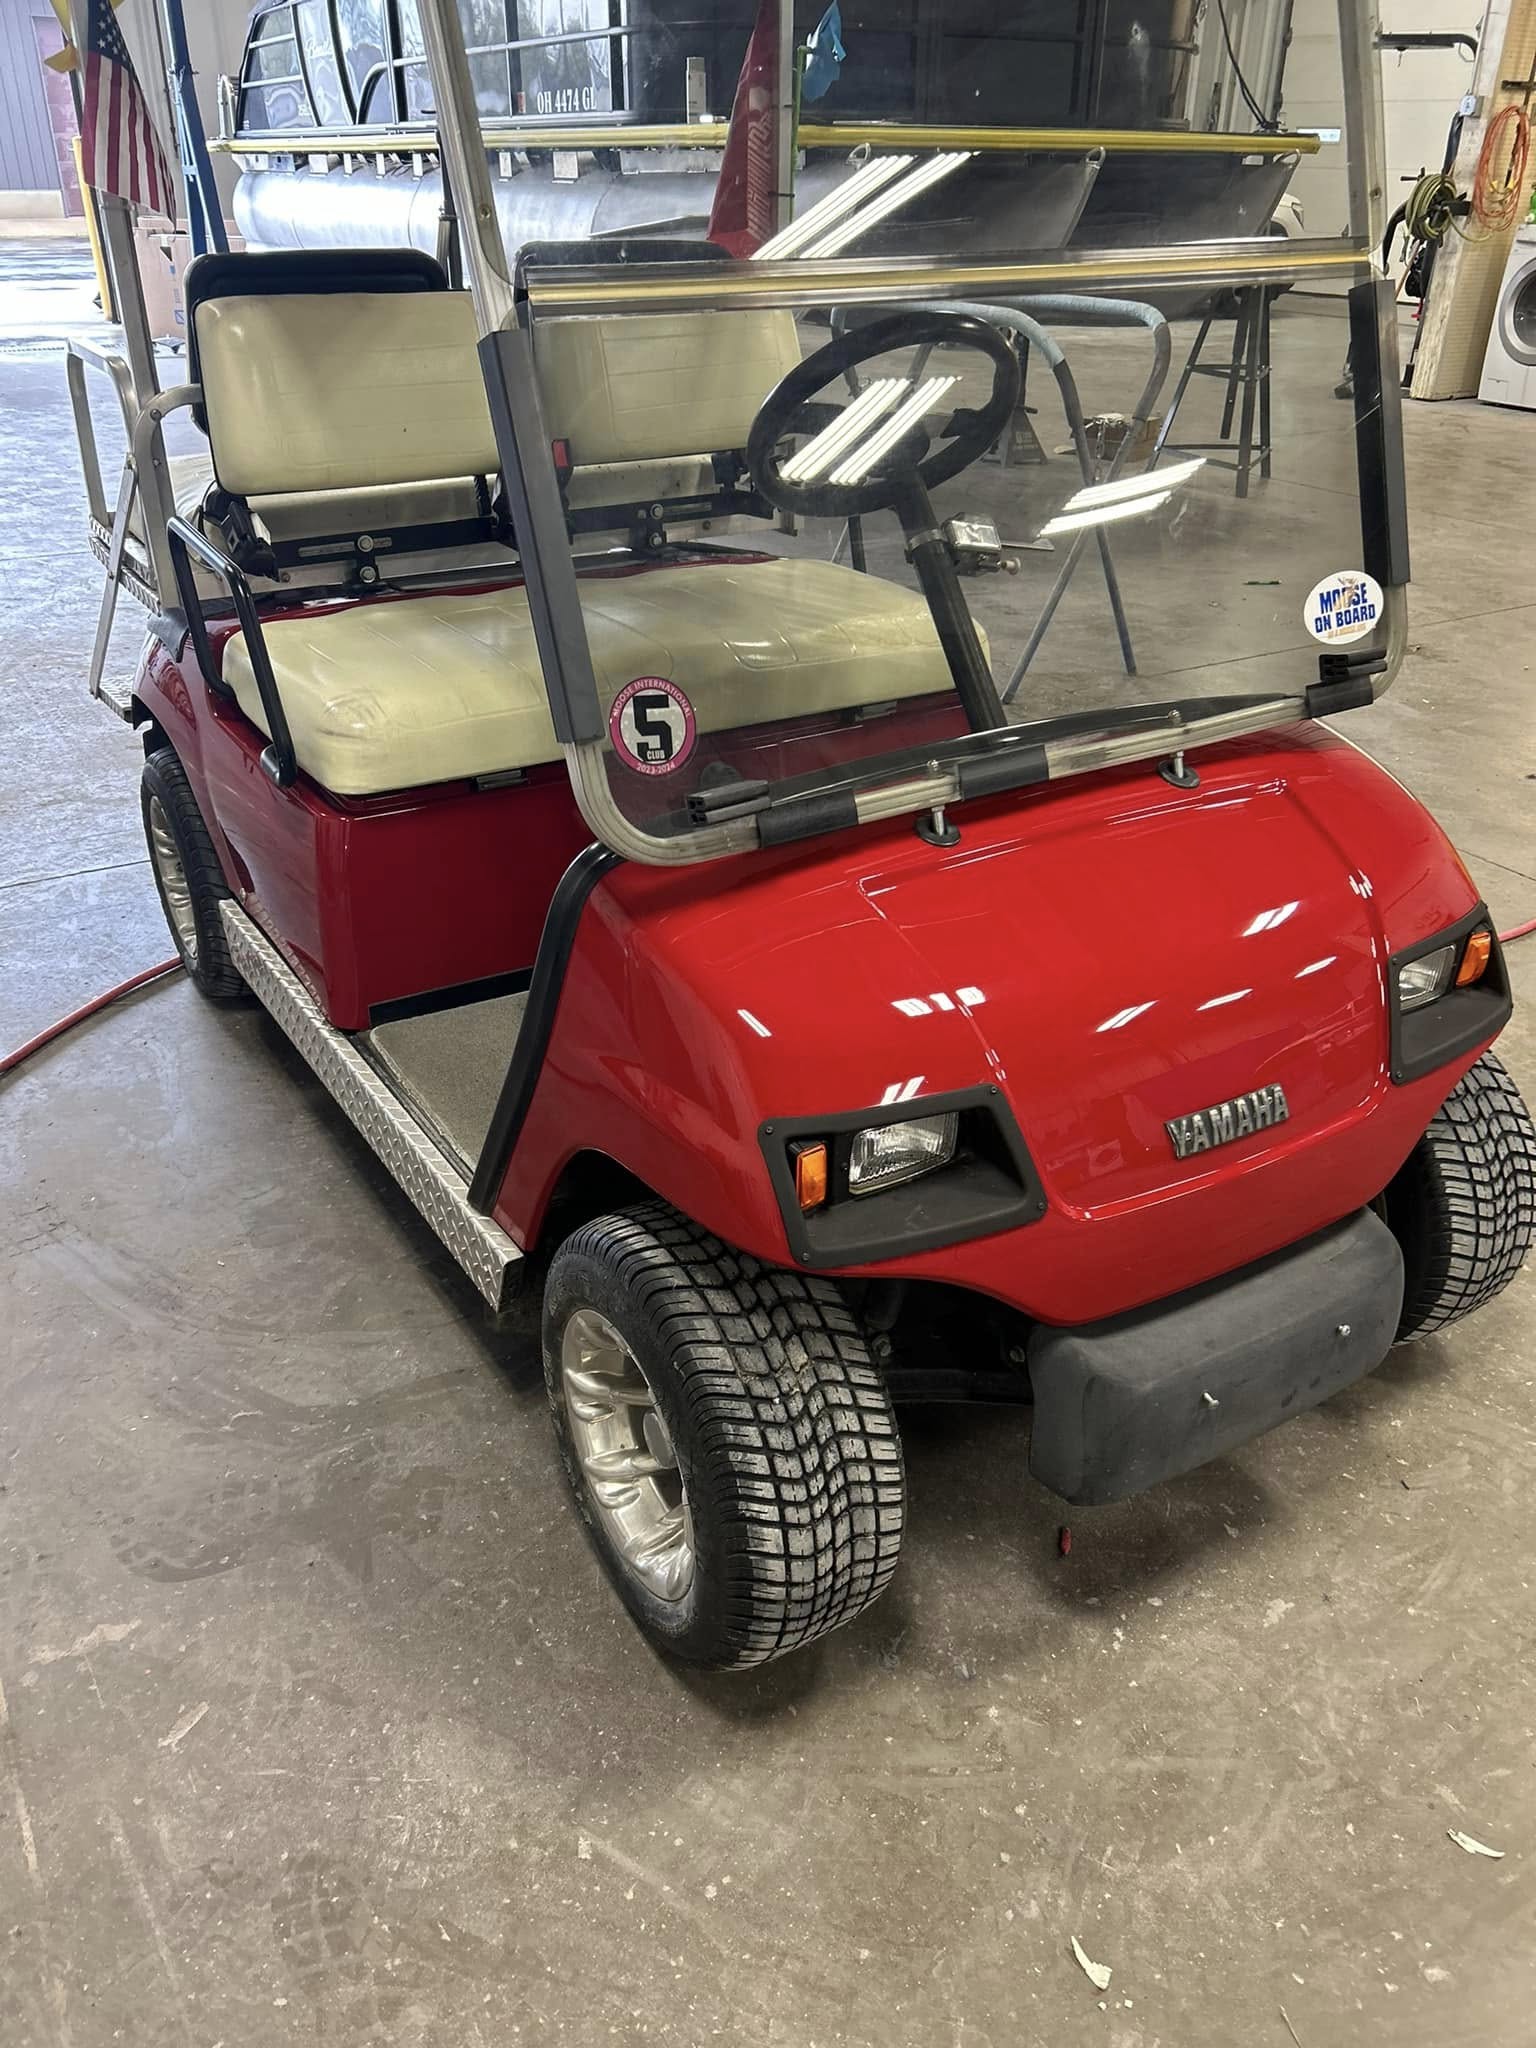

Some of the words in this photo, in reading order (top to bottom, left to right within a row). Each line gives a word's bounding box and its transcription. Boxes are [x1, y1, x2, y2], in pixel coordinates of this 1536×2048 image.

[537, 91, 553, 113] OH
[554, 88, 579, 112] 4474
[1319, 583, 1368, 614] MOSE
[1314, 614, 1332, 633] ON
[1336, 604, 1376, 627] BOARD
[634, 679, 691, 718] INTERNATIONAL
[632, 694, 674, 762] 5
[646, 750, 666, 760] CLUB
[1166, 1085, 1289, 1158] YAMAHA
